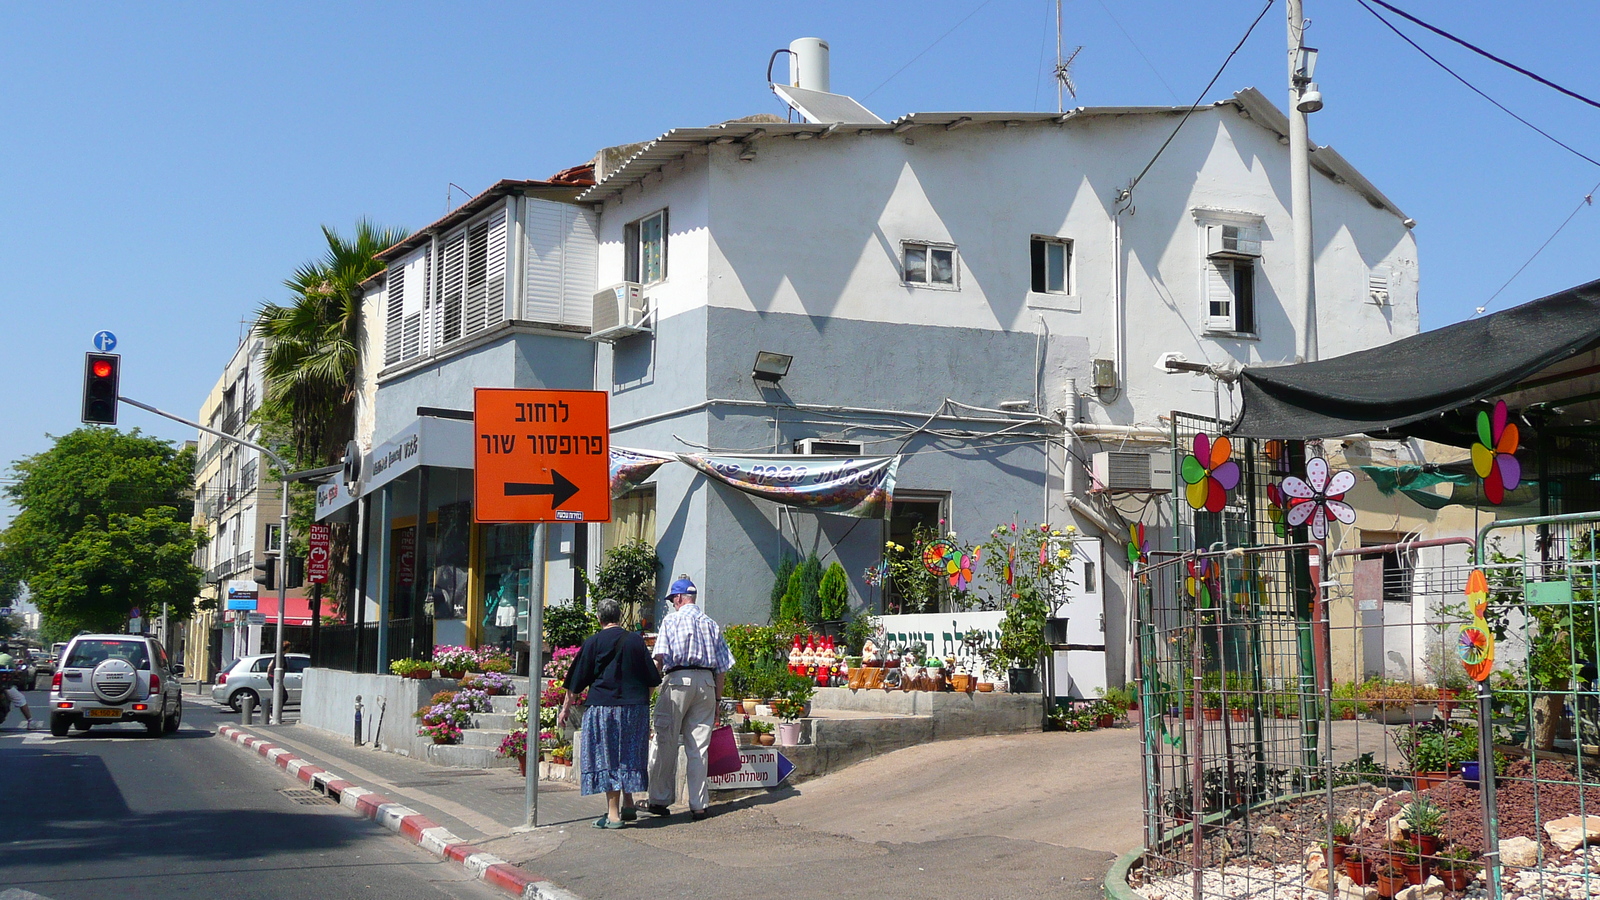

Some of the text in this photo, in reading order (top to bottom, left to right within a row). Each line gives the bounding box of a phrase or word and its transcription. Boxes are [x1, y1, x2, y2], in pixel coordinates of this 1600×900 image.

[515, 400, 569, 423] לרחוב
[481, 434, 516, 454] שור
[526, 435, 603, 455] פרופסור
[740, 753, 775, 764] חניה חינם
[739, 769, 769, 783] משתלת
